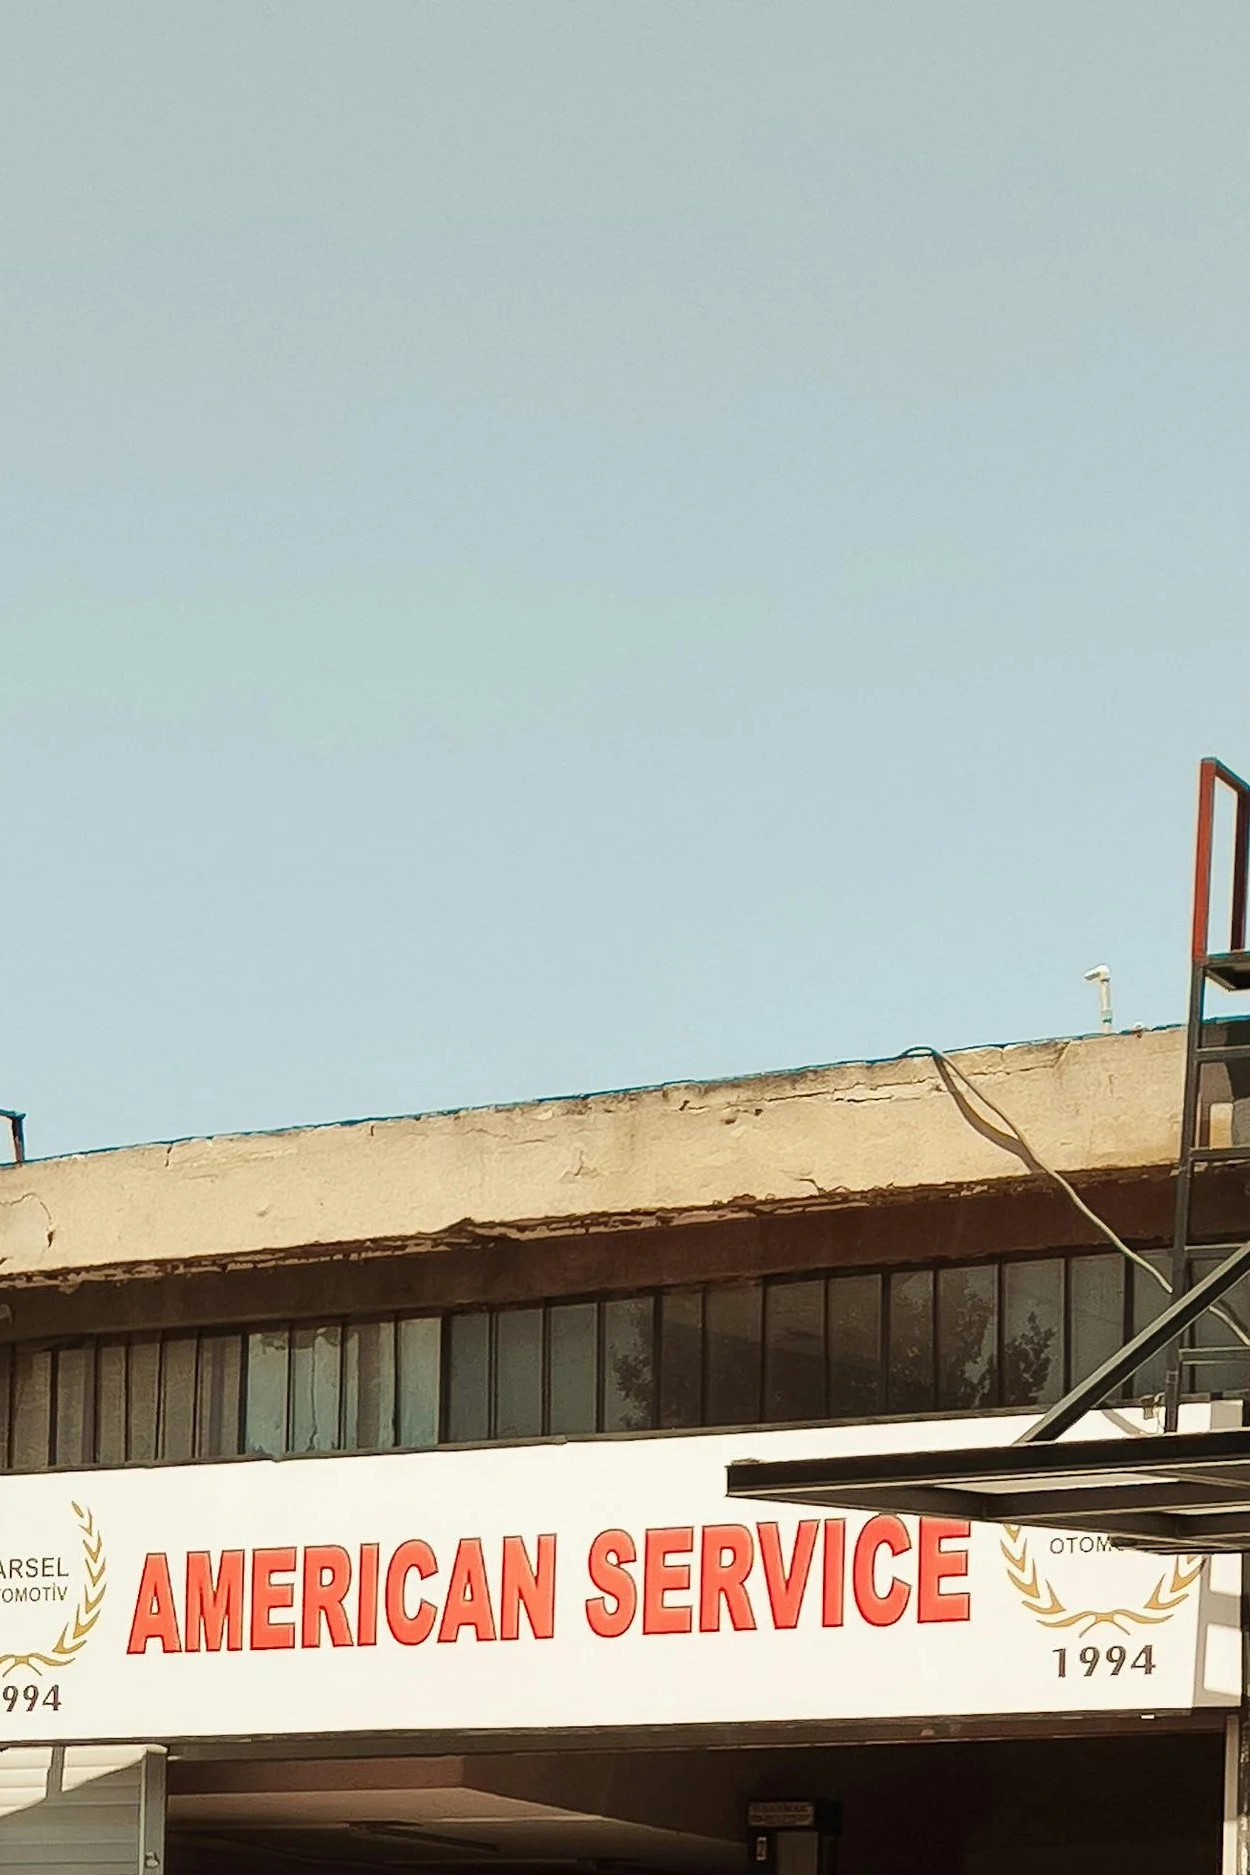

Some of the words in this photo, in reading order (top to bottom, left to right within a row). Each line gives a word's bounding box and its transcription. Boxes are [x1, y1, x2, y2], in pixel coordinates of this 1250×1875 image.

[126, 1532, 557, 1655] AMERICAN
[585, 1512, 972, 1638] SERVICE
[1052, 1645, 1156, 1678] 1994
